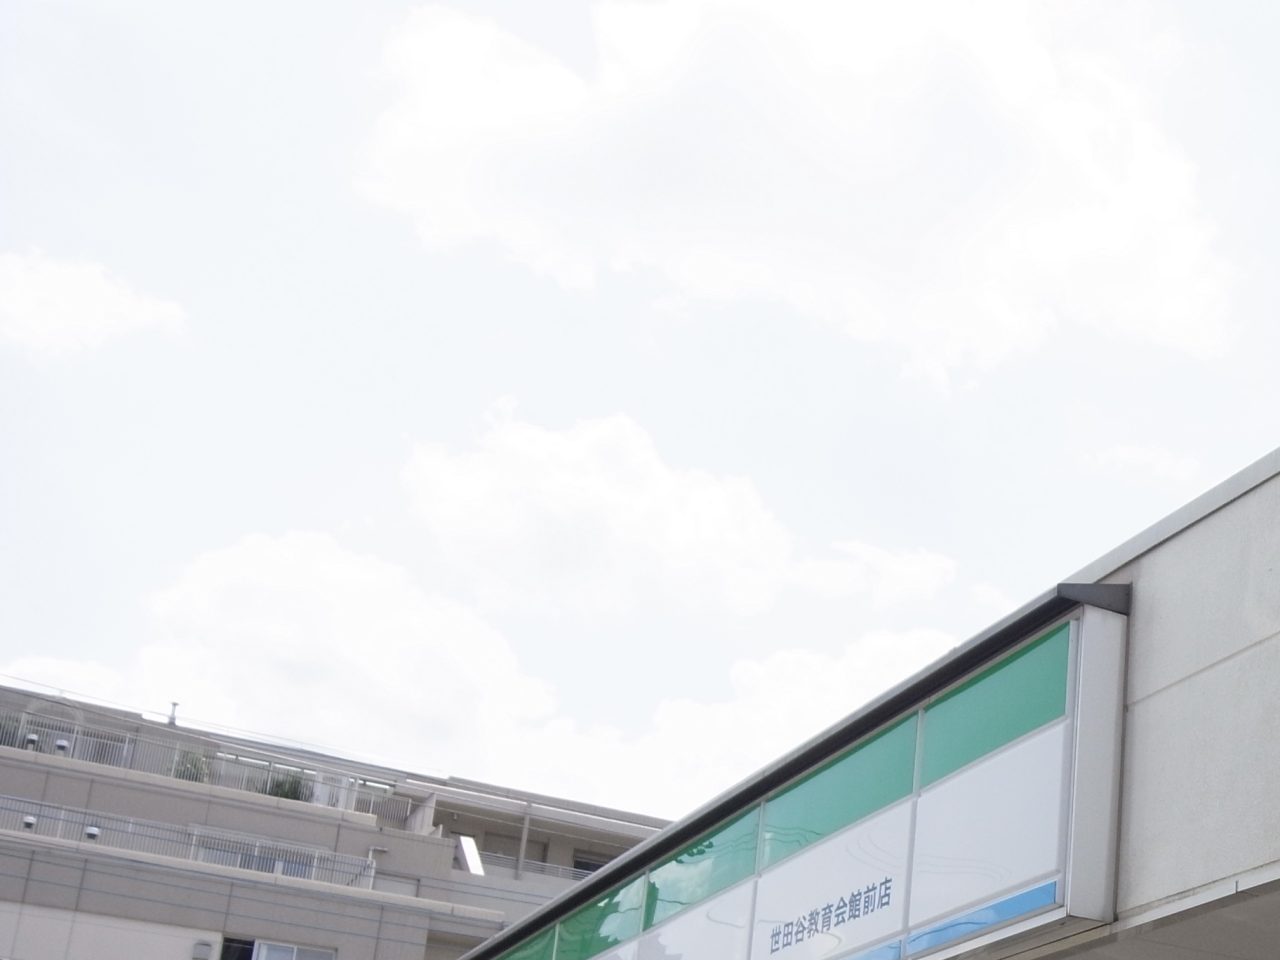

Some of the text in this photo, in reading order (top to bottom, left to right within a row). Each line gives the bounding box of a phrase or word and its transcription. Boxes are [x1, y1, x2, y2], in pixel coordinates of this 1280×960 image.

[769, 876, 893, 955] 世田谷教育会館前店
